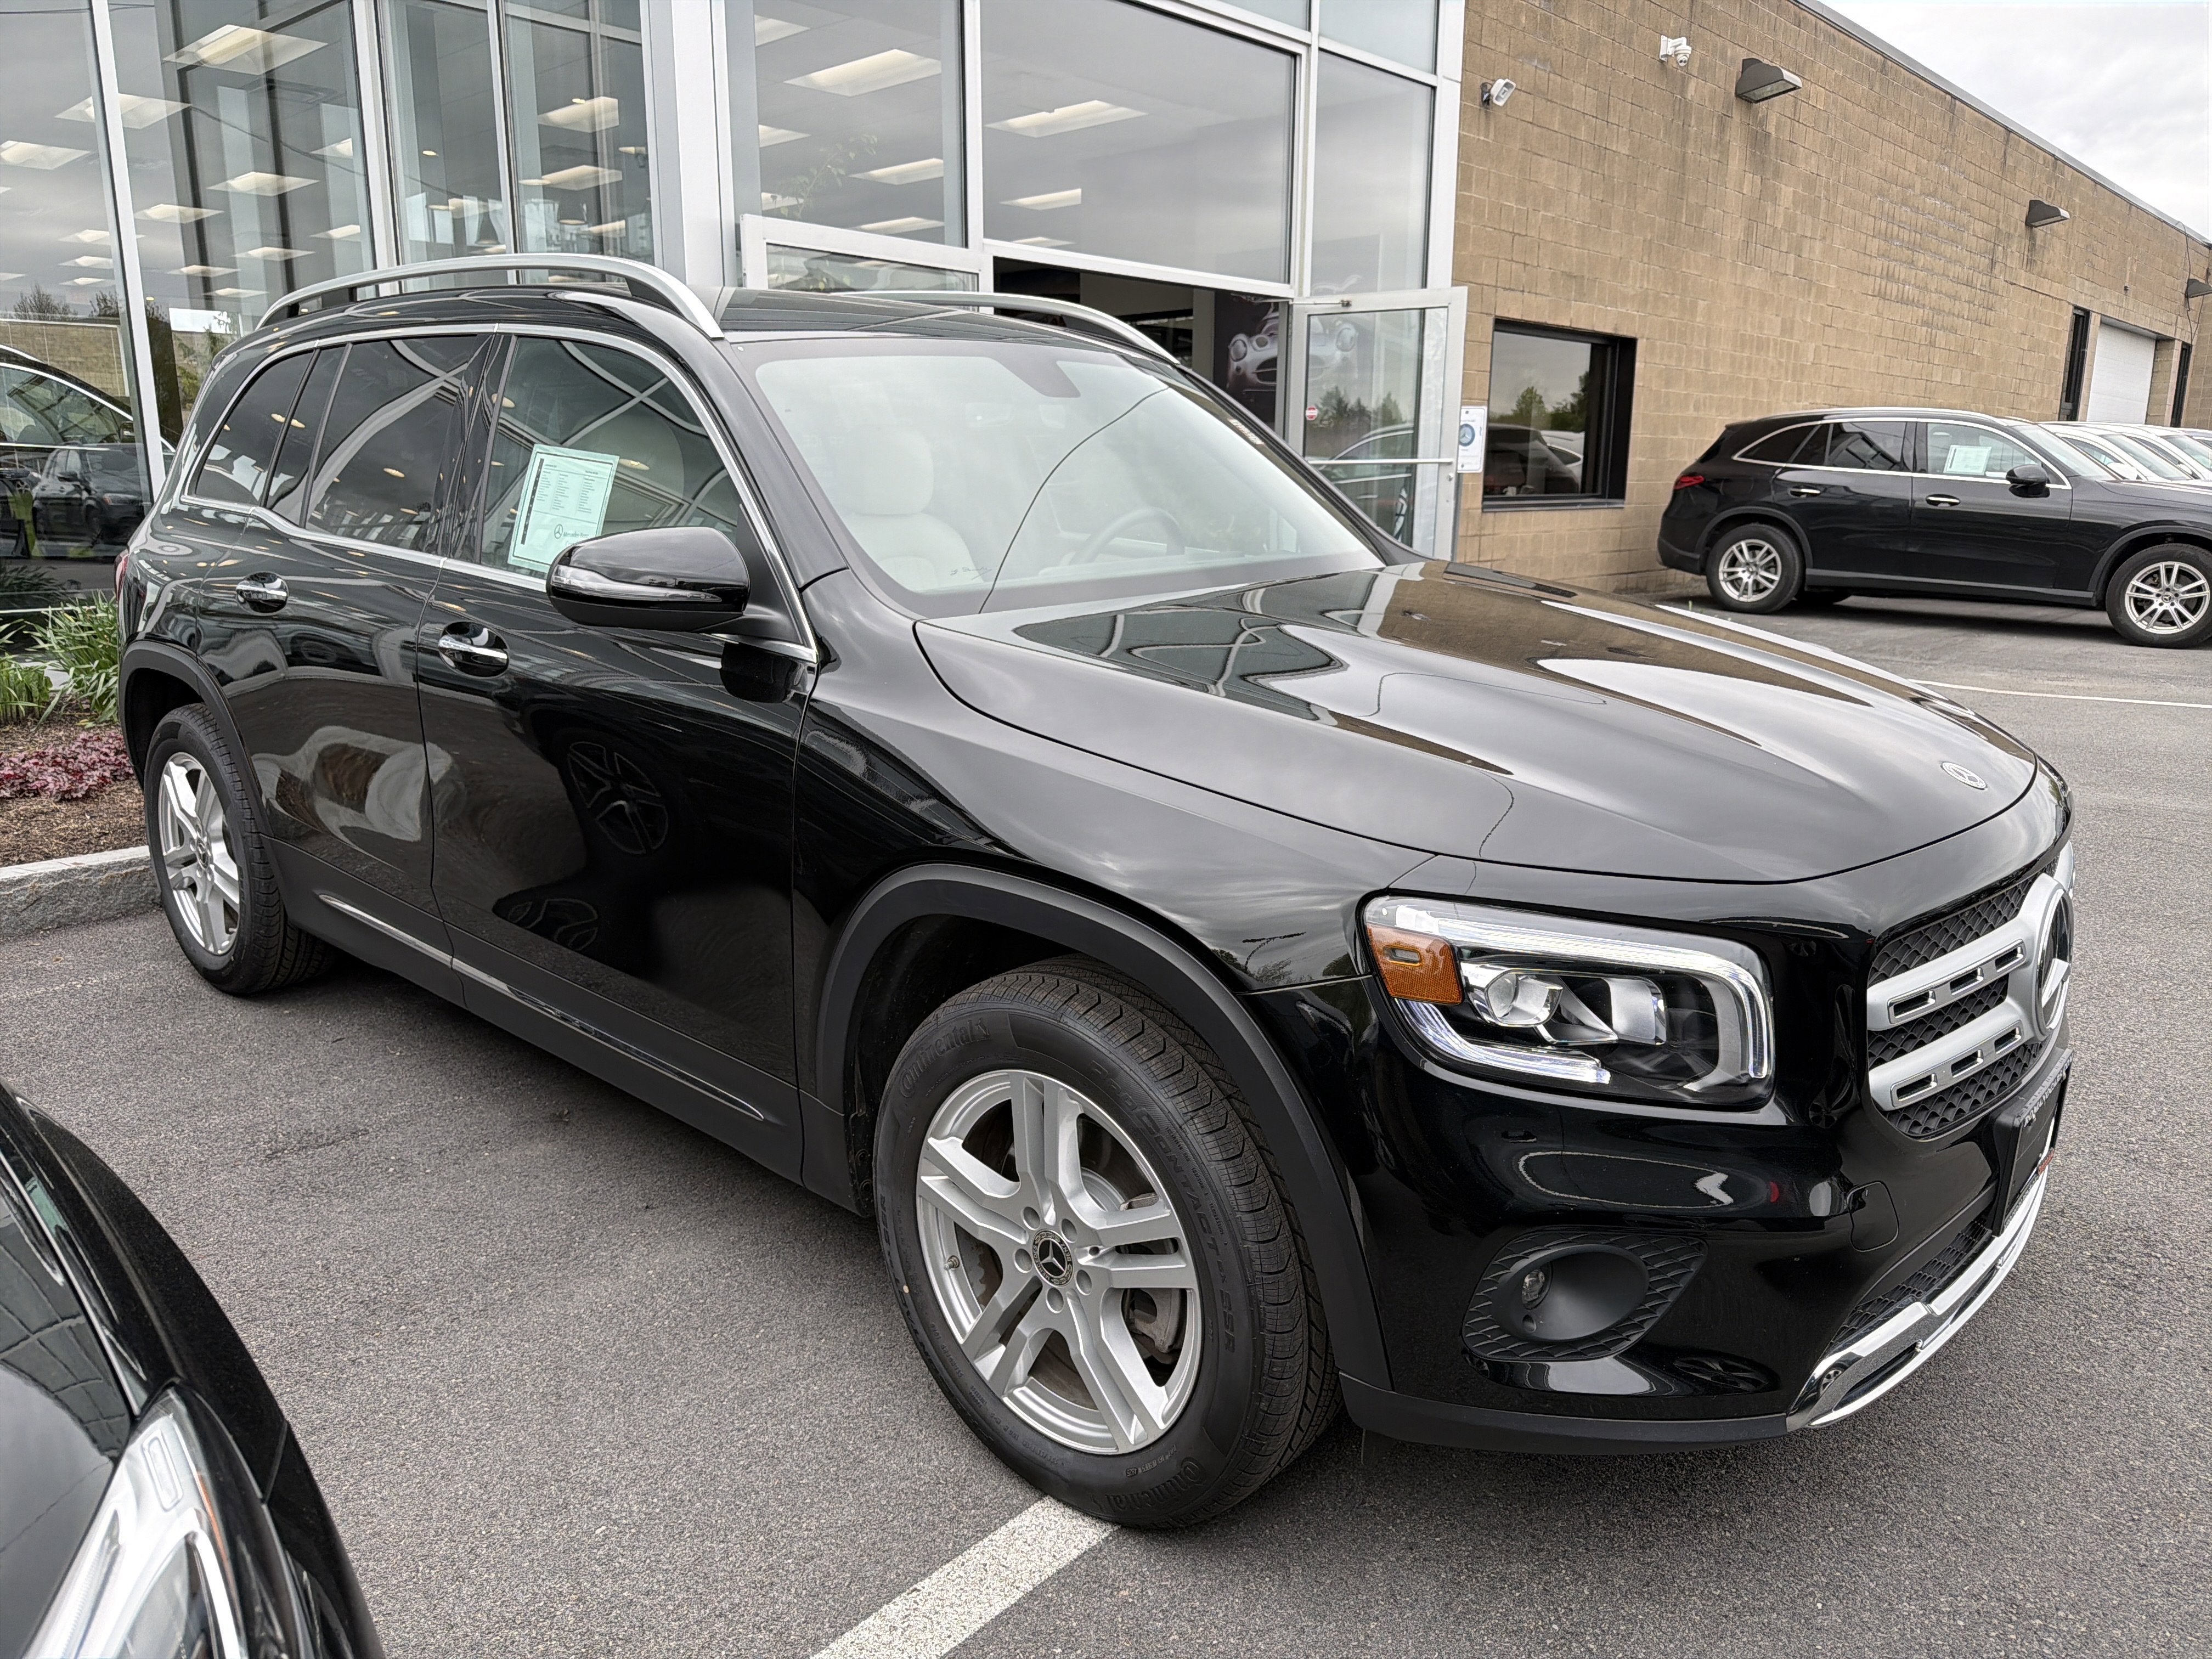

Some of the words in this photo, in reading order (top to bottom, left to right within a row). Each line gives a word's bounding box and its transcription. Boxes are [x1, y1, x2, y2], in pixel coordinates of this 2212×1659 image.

[900, 1019, 976, 1098] Continental
[1032, 1244, 1051, 1280] MERCEDES
[1060, 1241, 1071, 1262] BENZ
